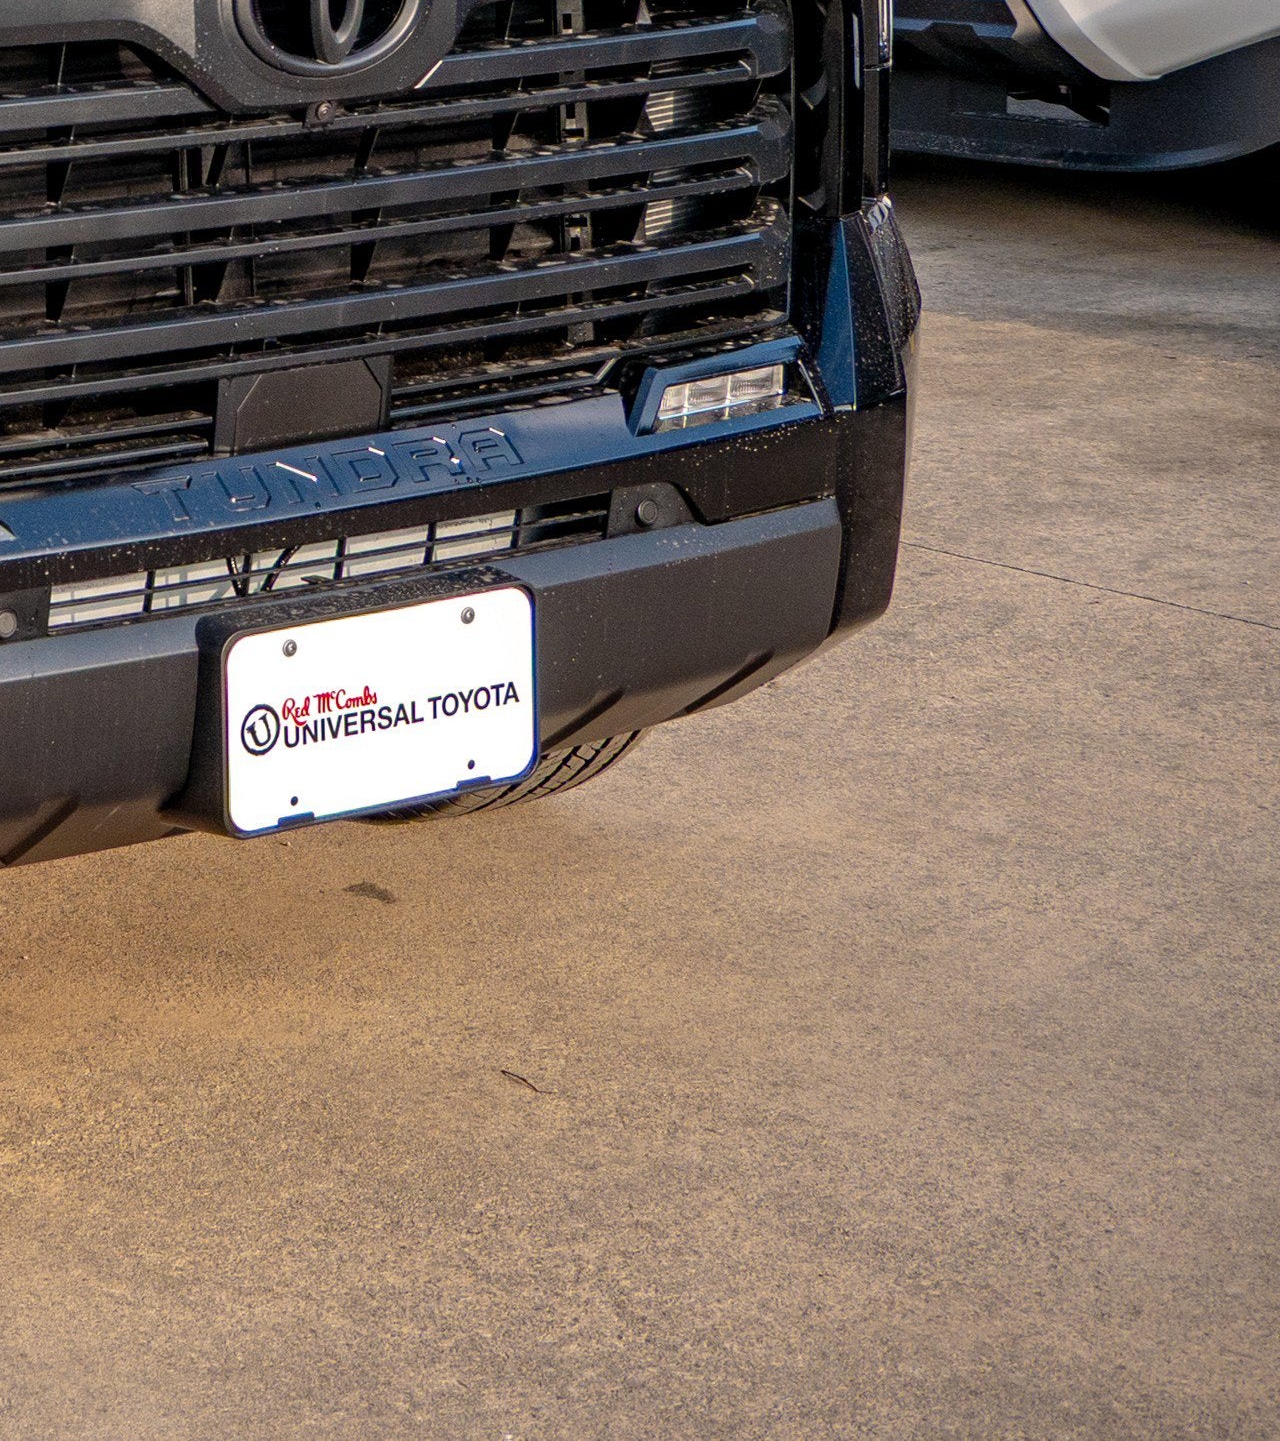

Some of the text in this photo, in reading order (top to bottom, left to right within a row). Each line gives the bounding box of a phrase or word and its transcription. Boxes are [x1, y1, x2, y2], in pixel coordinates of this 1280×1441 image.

[130, 425, 524, 522] TUNDRA
[282, 685, 377, 726] Red McCombs
[284, 681, 519, 748] UNIVERSAL TOYOTA
